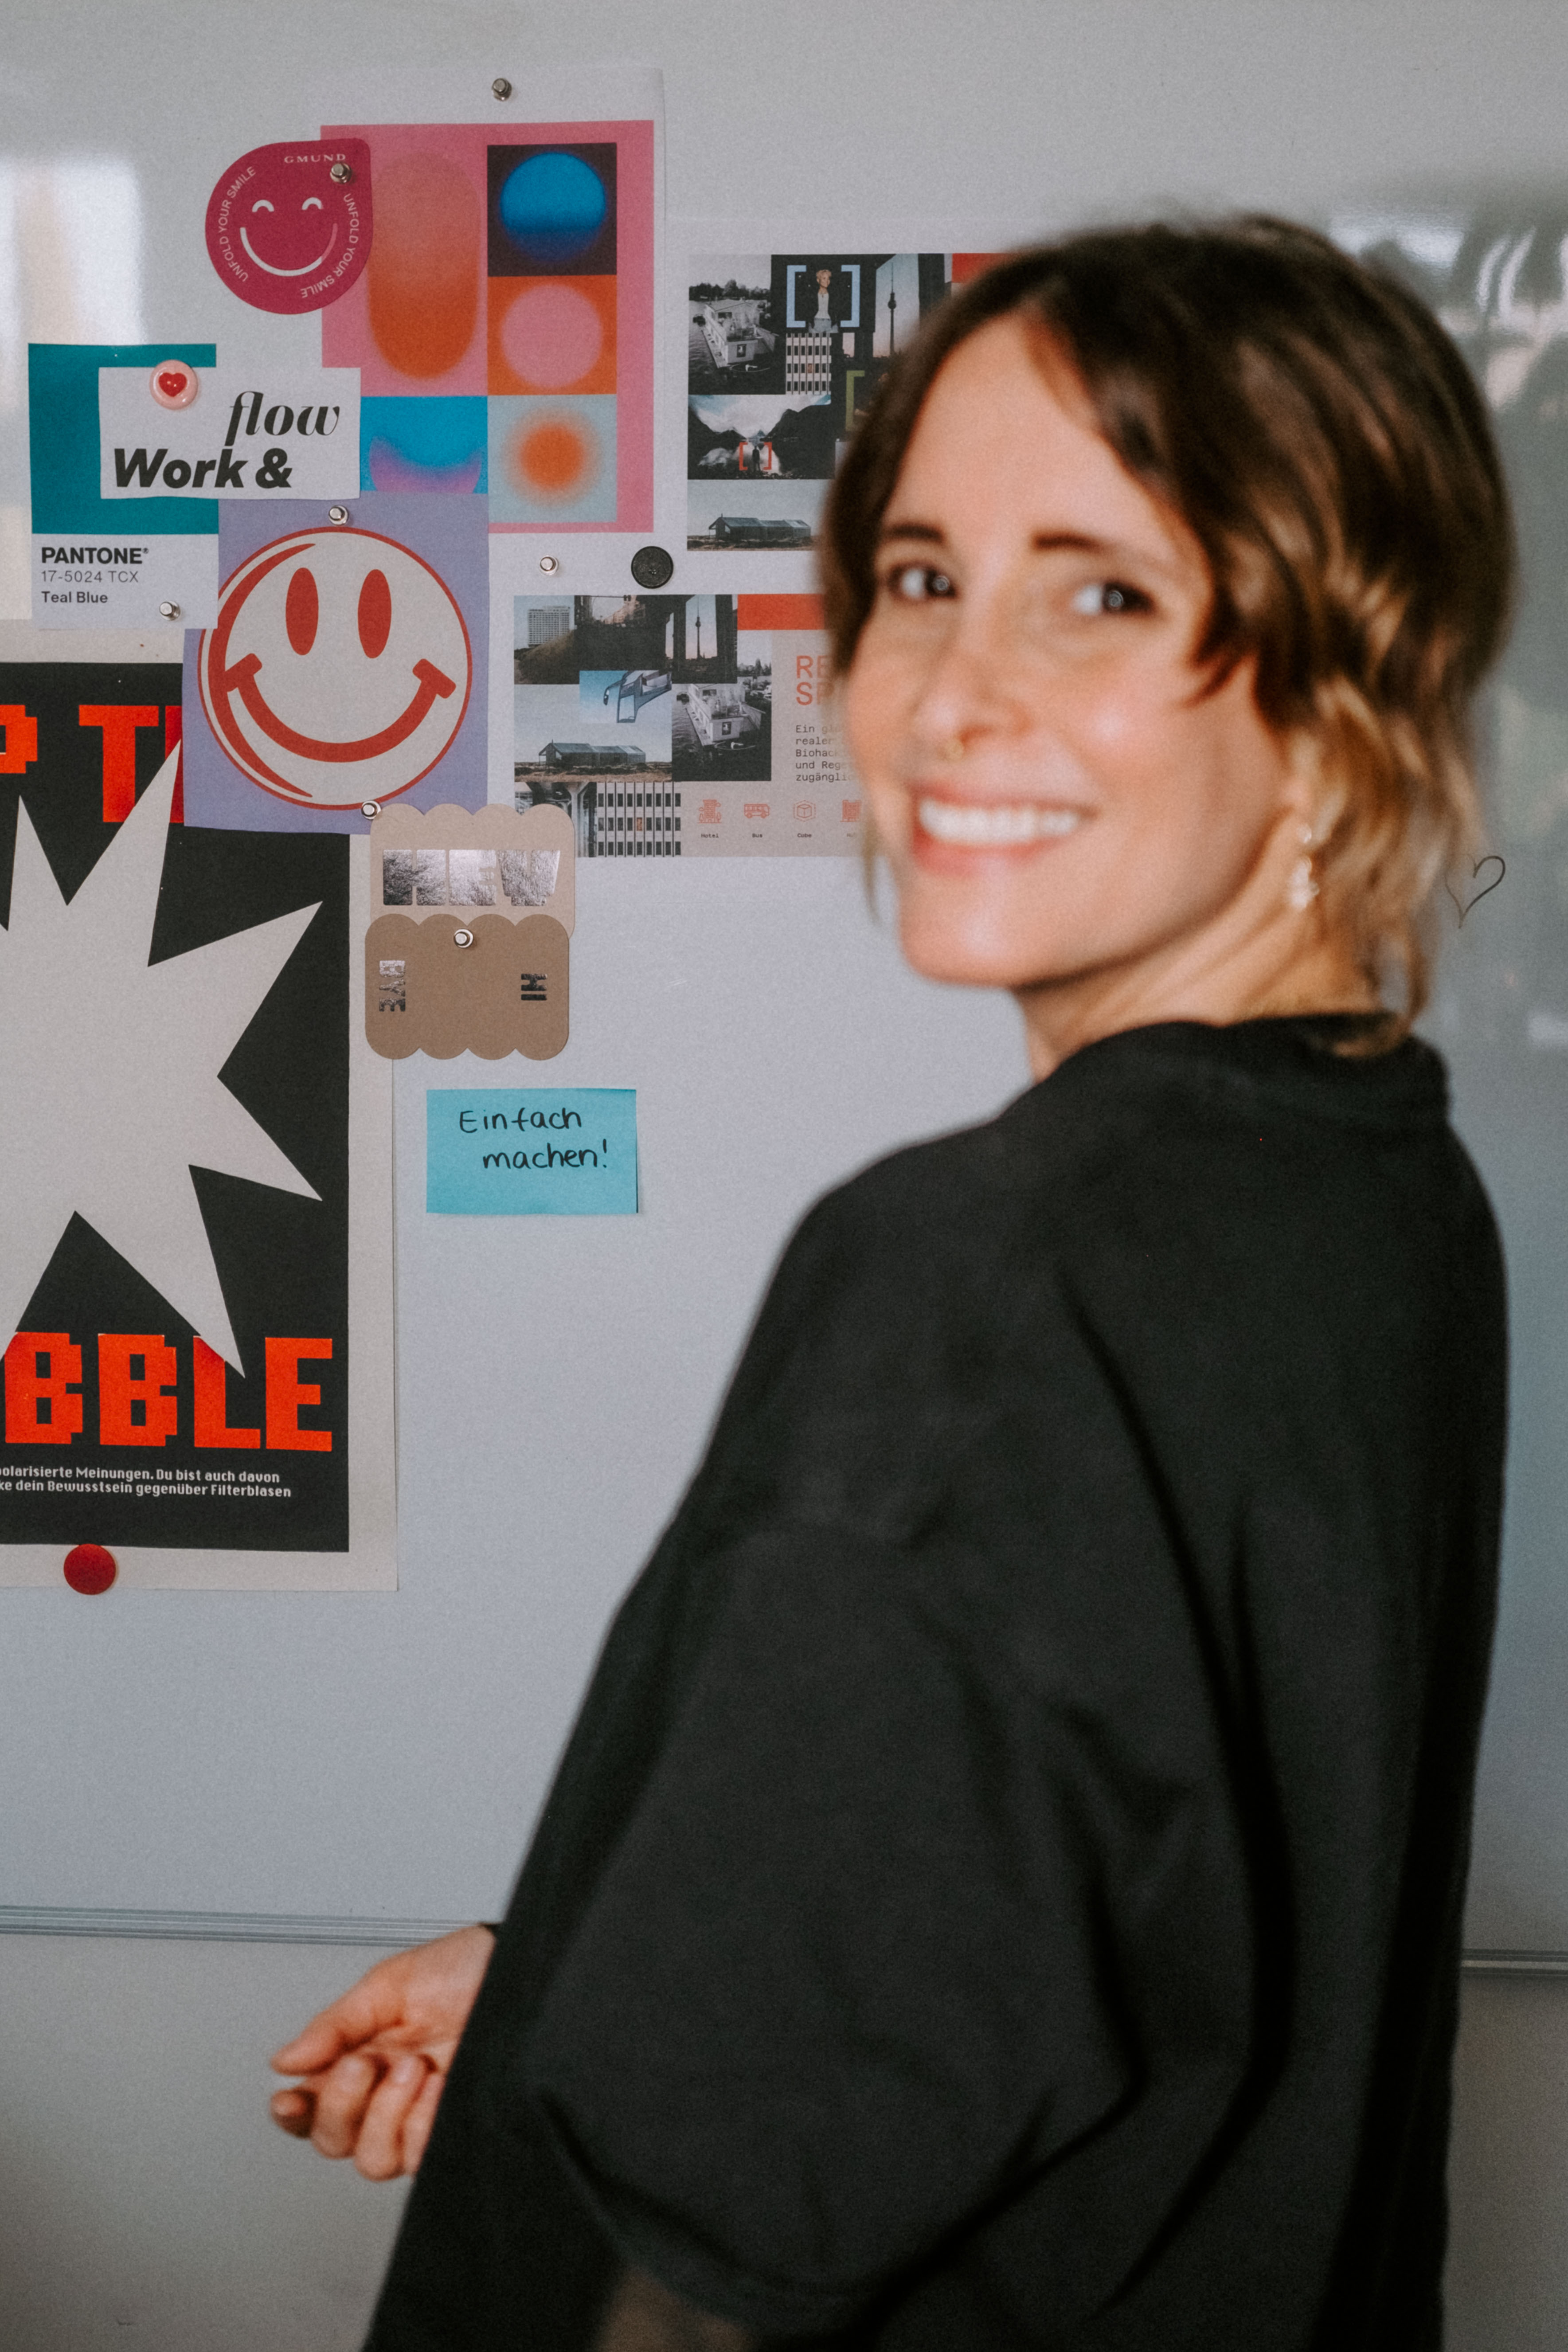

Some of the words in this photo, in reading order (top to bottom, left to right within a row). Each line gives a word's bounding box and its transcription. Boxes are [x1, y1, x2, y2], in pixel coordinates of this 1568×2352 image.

[284, 153, 346, 163] GMUND
[227, 166, 256, 199] SMILE
[218, 200, 231, 233] YOUR
[343, 193, 360, 244] UNFOLD
[219, 236, 249, 282] UNFOLD
[333, 247, 356, 277] YOUR
[300, 274, 335, 298] SMILE
[225, 391, 340, 446] flow
[113, 448, 249, 488] Work
[255, 447, 293, 489] &
[41, 570, 102, 583] 17-5024
[108, 571, 139, 583] TCX
[41, 591, 72, 603] Teal
[77, 591, 108, 603] Blue
[796, 724, 815, 733] Ein
[796, 761, 815, 769] und
[379, 960, 406, 1012] BYE
[521, 974, 547, 1001] HI
[459, 1108, 582, 1133] Einfach
[482, 1139, 607, 1170] machen!
[16, 1480, 44, 1491] dein
[47, 1481, 133, 1493] Bewusstsein
[136, 1483, 208, 1497] gegenüber
[211, 1484, 291, 1497] Filterblasen
[76, 1467, 154, 1482] Meinungen.
[156, 1469, 172, 1480] Du
[176, 1469, 201, 1481] bist
[205, 1471, 235, 1482] auch
[239, 1471, 280, 1483] davon
